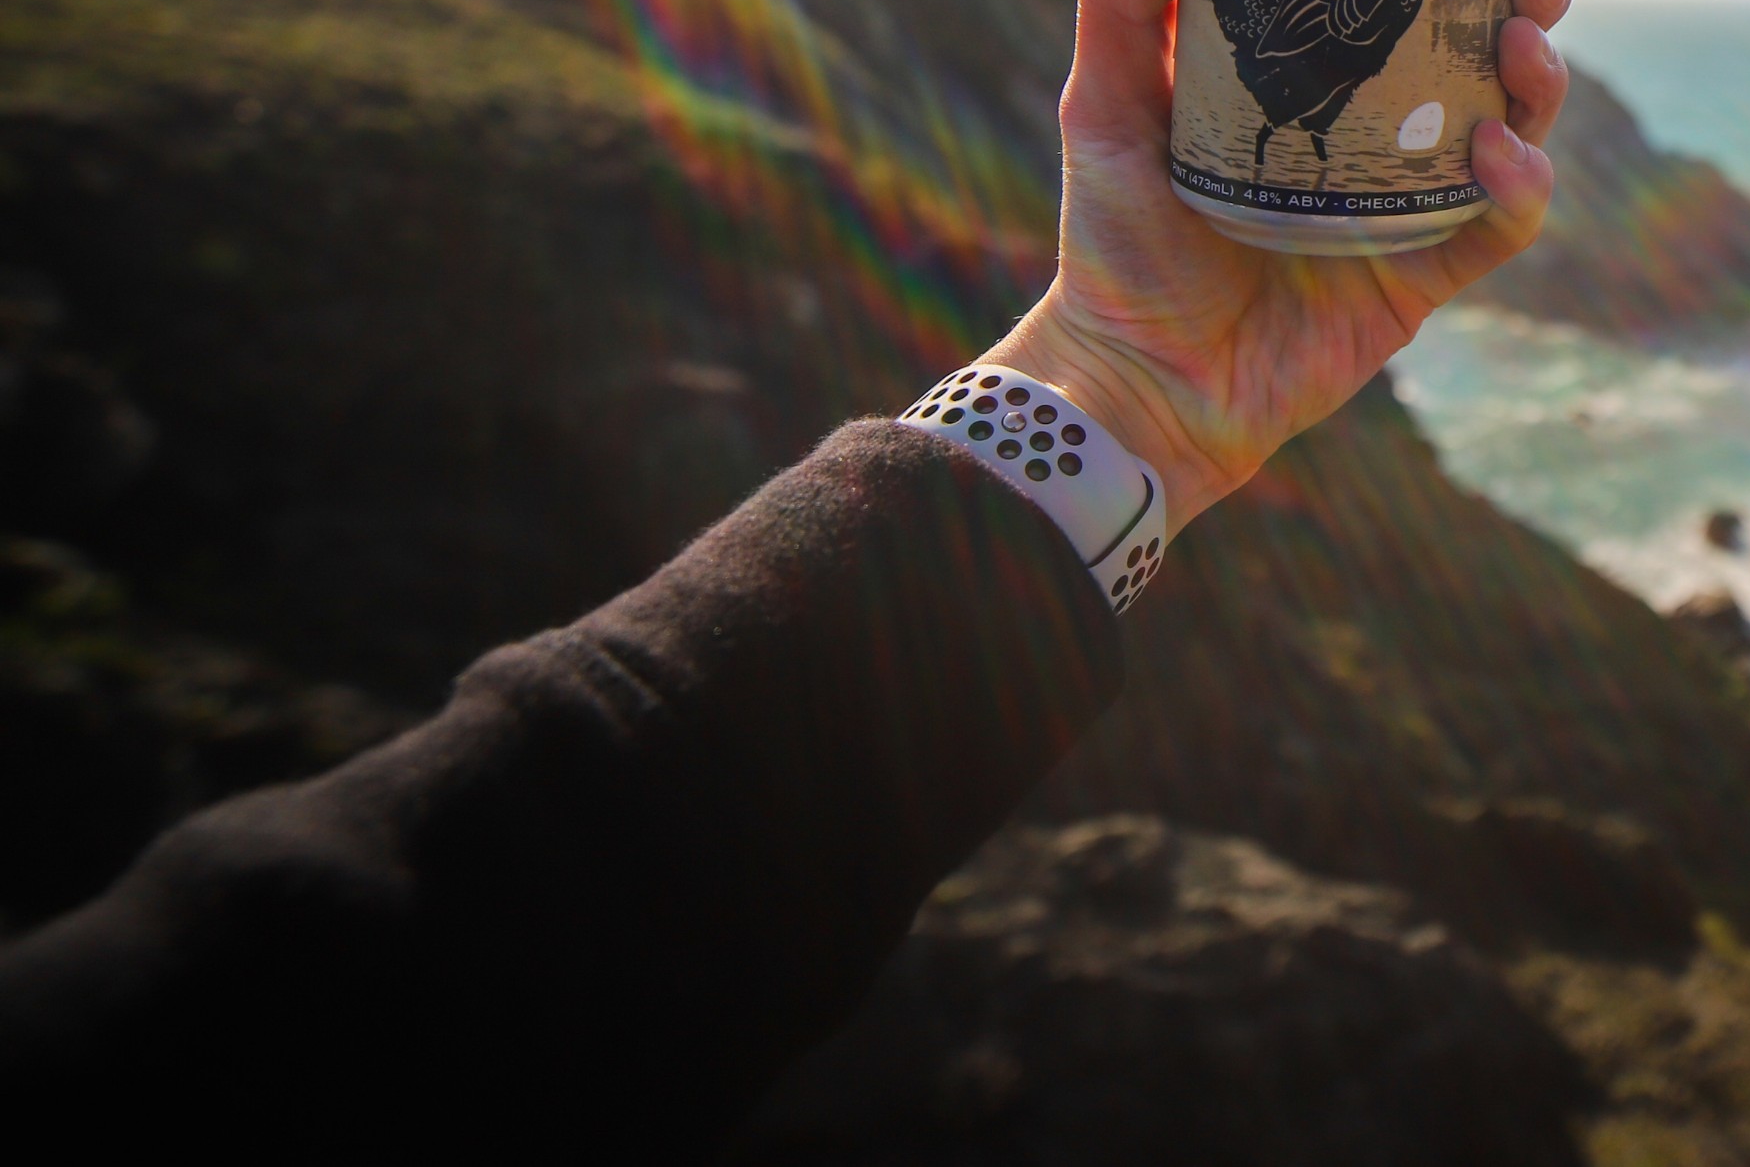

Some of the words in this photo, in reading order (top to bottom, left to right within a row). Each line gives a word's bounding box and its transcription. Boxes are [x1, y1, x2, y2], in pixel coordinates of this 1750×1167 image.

[1188, 172, 1235, 197] (473mL)
[1243, 188, 1282, 205] 4.8%
[1287, 194, 1327, 208] ABV
[1345, 196, 1408, 209] CHECK
[1413, 193, 1445, 207] THE
[1448, 185, 1479, 202] DATE
